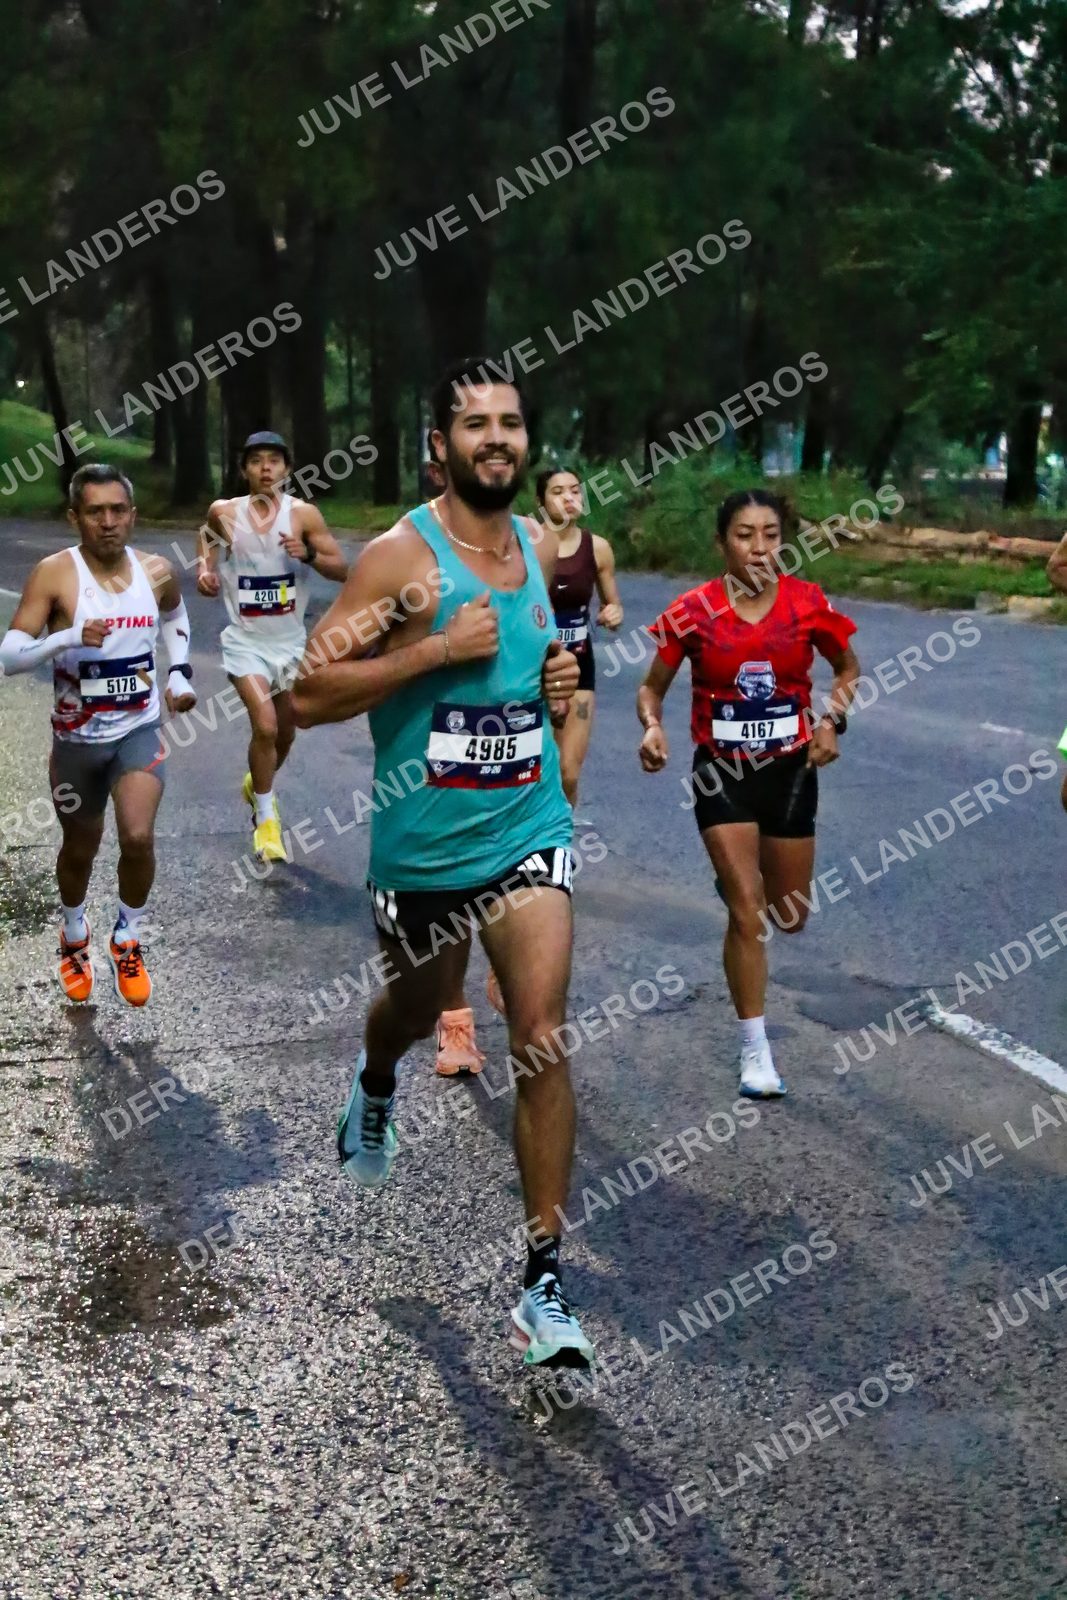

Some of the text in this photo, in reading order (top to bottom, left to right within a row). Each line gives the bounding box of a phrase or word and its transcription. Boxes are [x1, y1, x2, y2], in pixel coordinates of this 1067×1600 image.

[254, 590, 279, 602] 4201
[105, 616, 154, 629] PTIME
[107, 677, 137, 694] 5178
[741, 721, 775, 739] 4167
[466, 737, 517, 761] 4985
